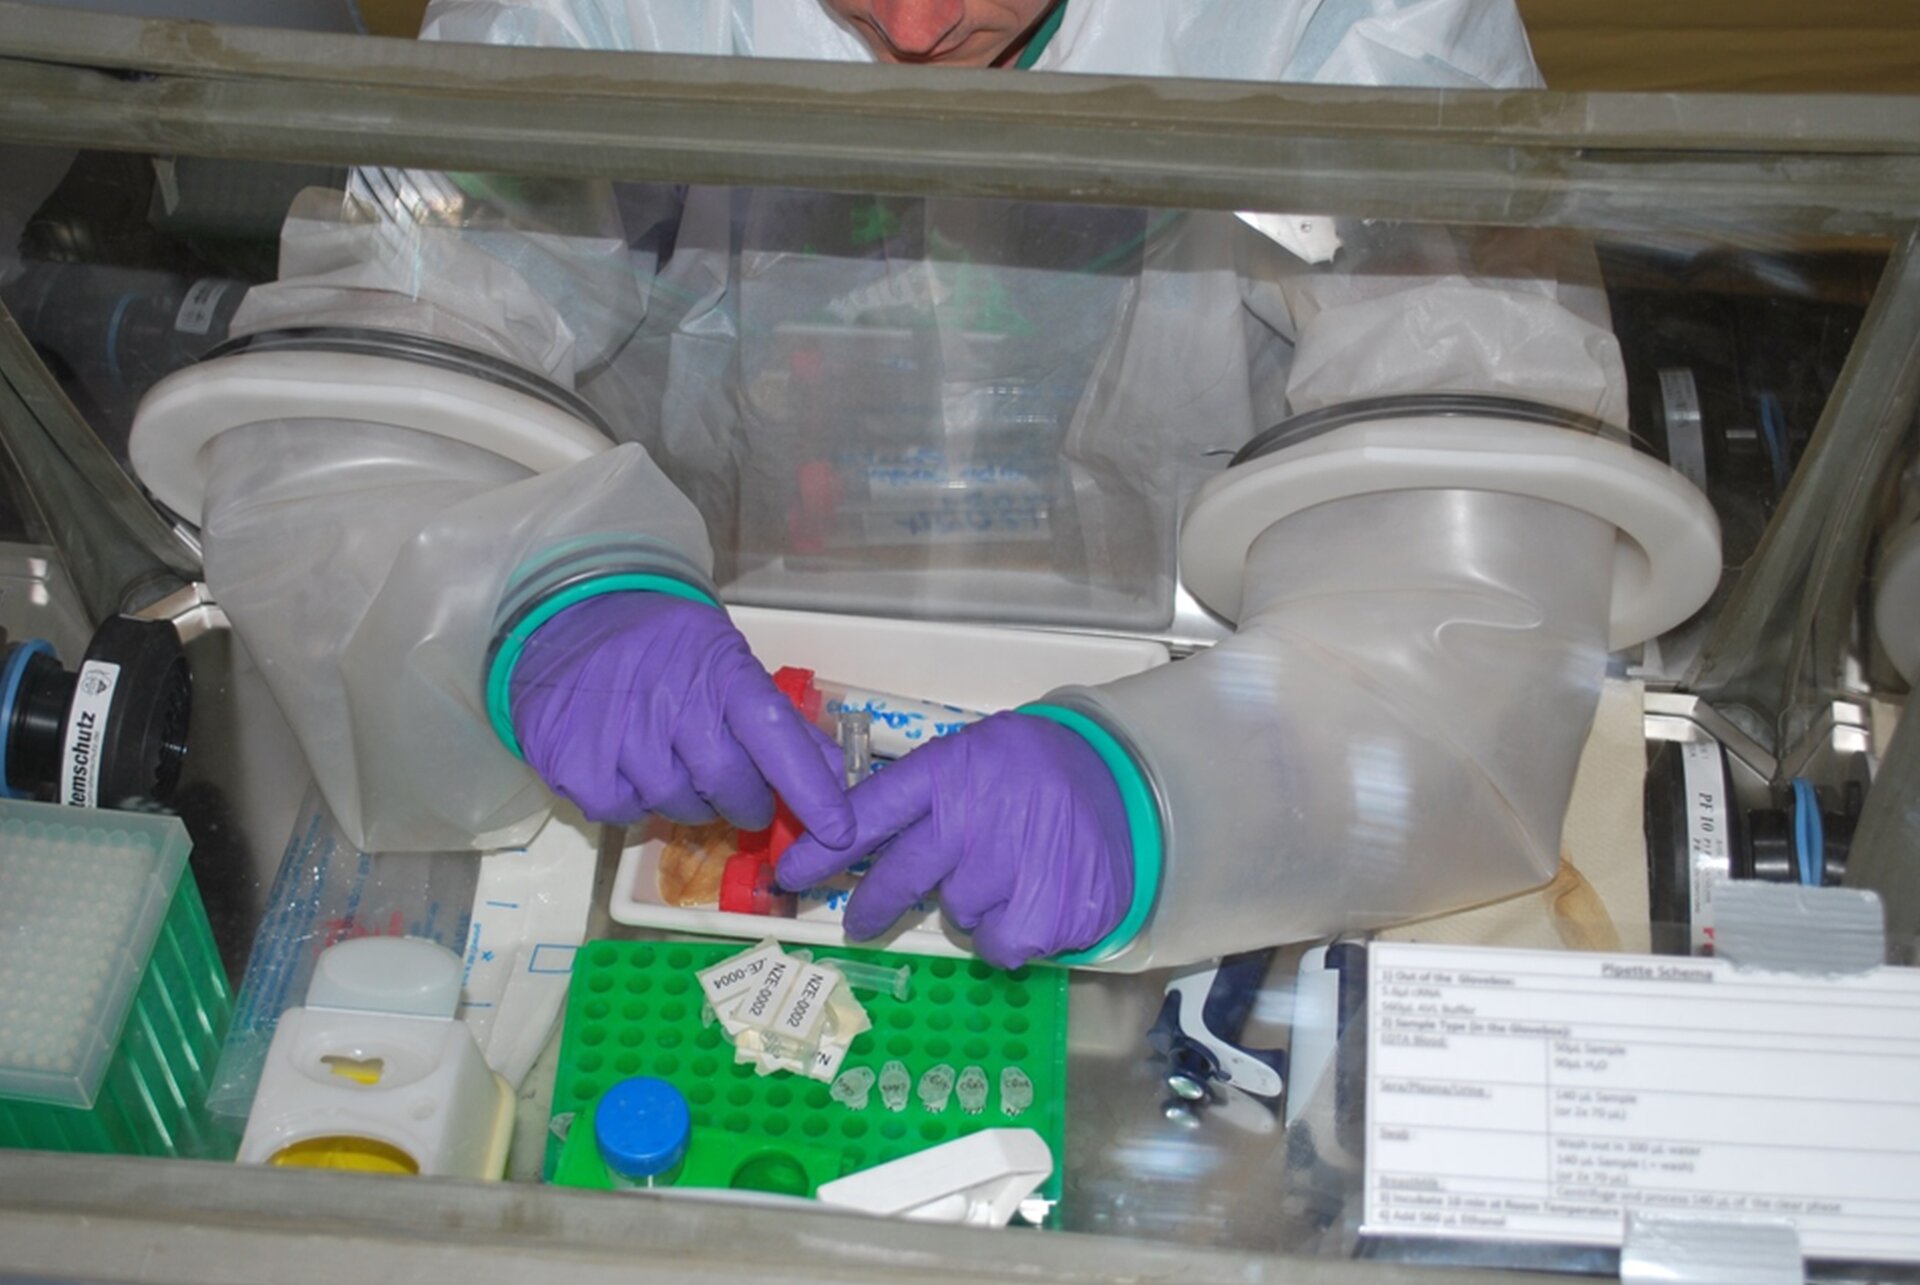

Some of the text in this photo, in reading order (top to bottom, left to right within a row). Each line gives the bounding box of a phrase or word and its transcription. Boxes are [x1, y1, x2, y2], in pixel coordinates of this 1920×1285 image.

[1698, 792, 1714, 814] PF
[1700, 815, 1714, 832] 10
[713, 956, 768, 990] ZE-0004
[1396, 973, 1416, 983] Out
[1419, 973, 1430, 983] of
[1433, 974, 1451, 984] the
[1601, 963, 1713, 982] Pipette Schema
[749, 961, 787, 1017] NZE-0002
[786, 973, 825, 1029] NZE-0002
[1442, 1004, 1475, 1015] Buffer
[1395, 1019, 1435, 1031] Sample
[1440, 1020, 1466, 1032] Type
[1487, 1022, 1506, 1032] the
[1381, 1034, 1410, 1045] EDTA
[1585, 1043, 1626, 1056] Sample
[1556, 1090, 1576, 1100] 140
[1596, 1091, 1637, 1104] Sample
[1556, 1139, 1587, 1149] Wash
[1591, 1140, 1610, 1150] out
[1614, 1141, 1624, 1150] in
[1669, 1145, 1700, 1156] water
[1557, 1155, 1577, 1165] 140
[1598, 1157, 1638, 1169] Sample
[1393, 1194, 1443, 1206] Incubate
[1464, 1197, 1486, 1208] min
[1490, 1199, 1502, 1209] at
[1505, 1199, 1540, 1211] Room
[1543, 1201, 1619, 1216] Temperature
[1556, 1187, 1616, 1202] Centrifuge
[1621, 1190, 1642, 1201] and
[1645, 1193, 1689, 1206] process
[1733, 1196, 1746, 1207] of
[1752, 1197, 1771, 1208] the
[1775, 1199, 1803, 1210] clear
[1806, 1201, 1842, 1213] phase
[1393, 1211, 1416, 1222] Add
[1461, 1213, 1505, 1227] Ethanol
